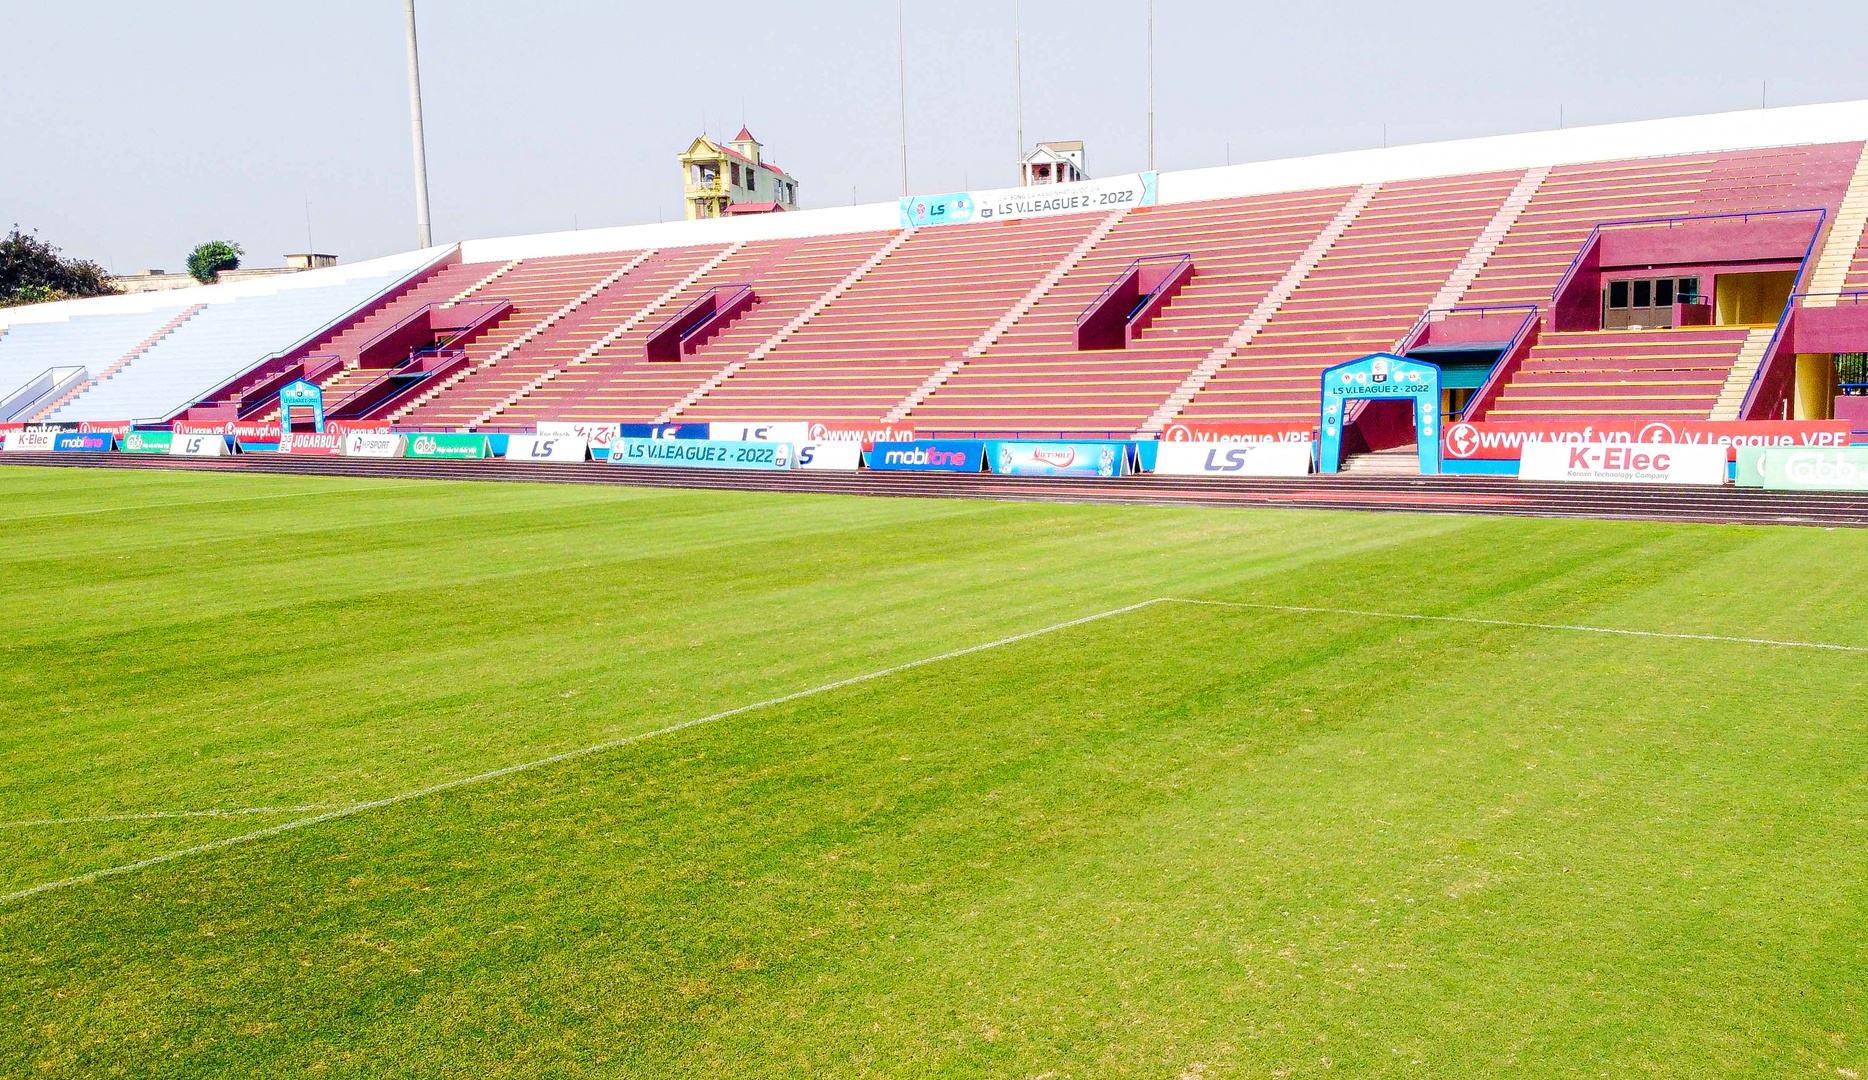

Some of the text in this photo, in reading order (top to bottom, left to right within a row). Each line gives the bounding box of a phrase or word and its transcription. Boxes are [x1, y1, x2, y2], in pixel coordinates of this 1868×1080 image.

[930, 205, 945, 215] LS
[999, 203, 1013, 214] LS
[1016, 196, 1079, 213] V.LEAGUE
[1082, 195, 1090, 207] 2
[1100, 190, 1133, 205] 2022
[1333, 387, 1344, 395] LS
[1346, 385, 1391, 394] V.LEAGUE
[1392, 385, 1399, 393] 2
[1405, 384, 1429, 393] 2022
[235, 424, 280, 440] www.vpf.vn
[185, 438, 201, 453] LS
[293, 434, 341, 448] JOGARBOLA
[531, 440, 555, 457] LS
[628, 444, 645, 457] LS
[648, 445, 715, 460] V.LEAGUE
[717, 447, 727, 461] 2
[736, 448, 773, 463] 2022
[885, 446, 967, 466] mobifone
[1204, 449, 1247, 471] LS
[1568, 447, 1670, 471] K-Elec
[1594, 471, 1633, 479] Technology
[1635, 472, 1669, 480] Company
